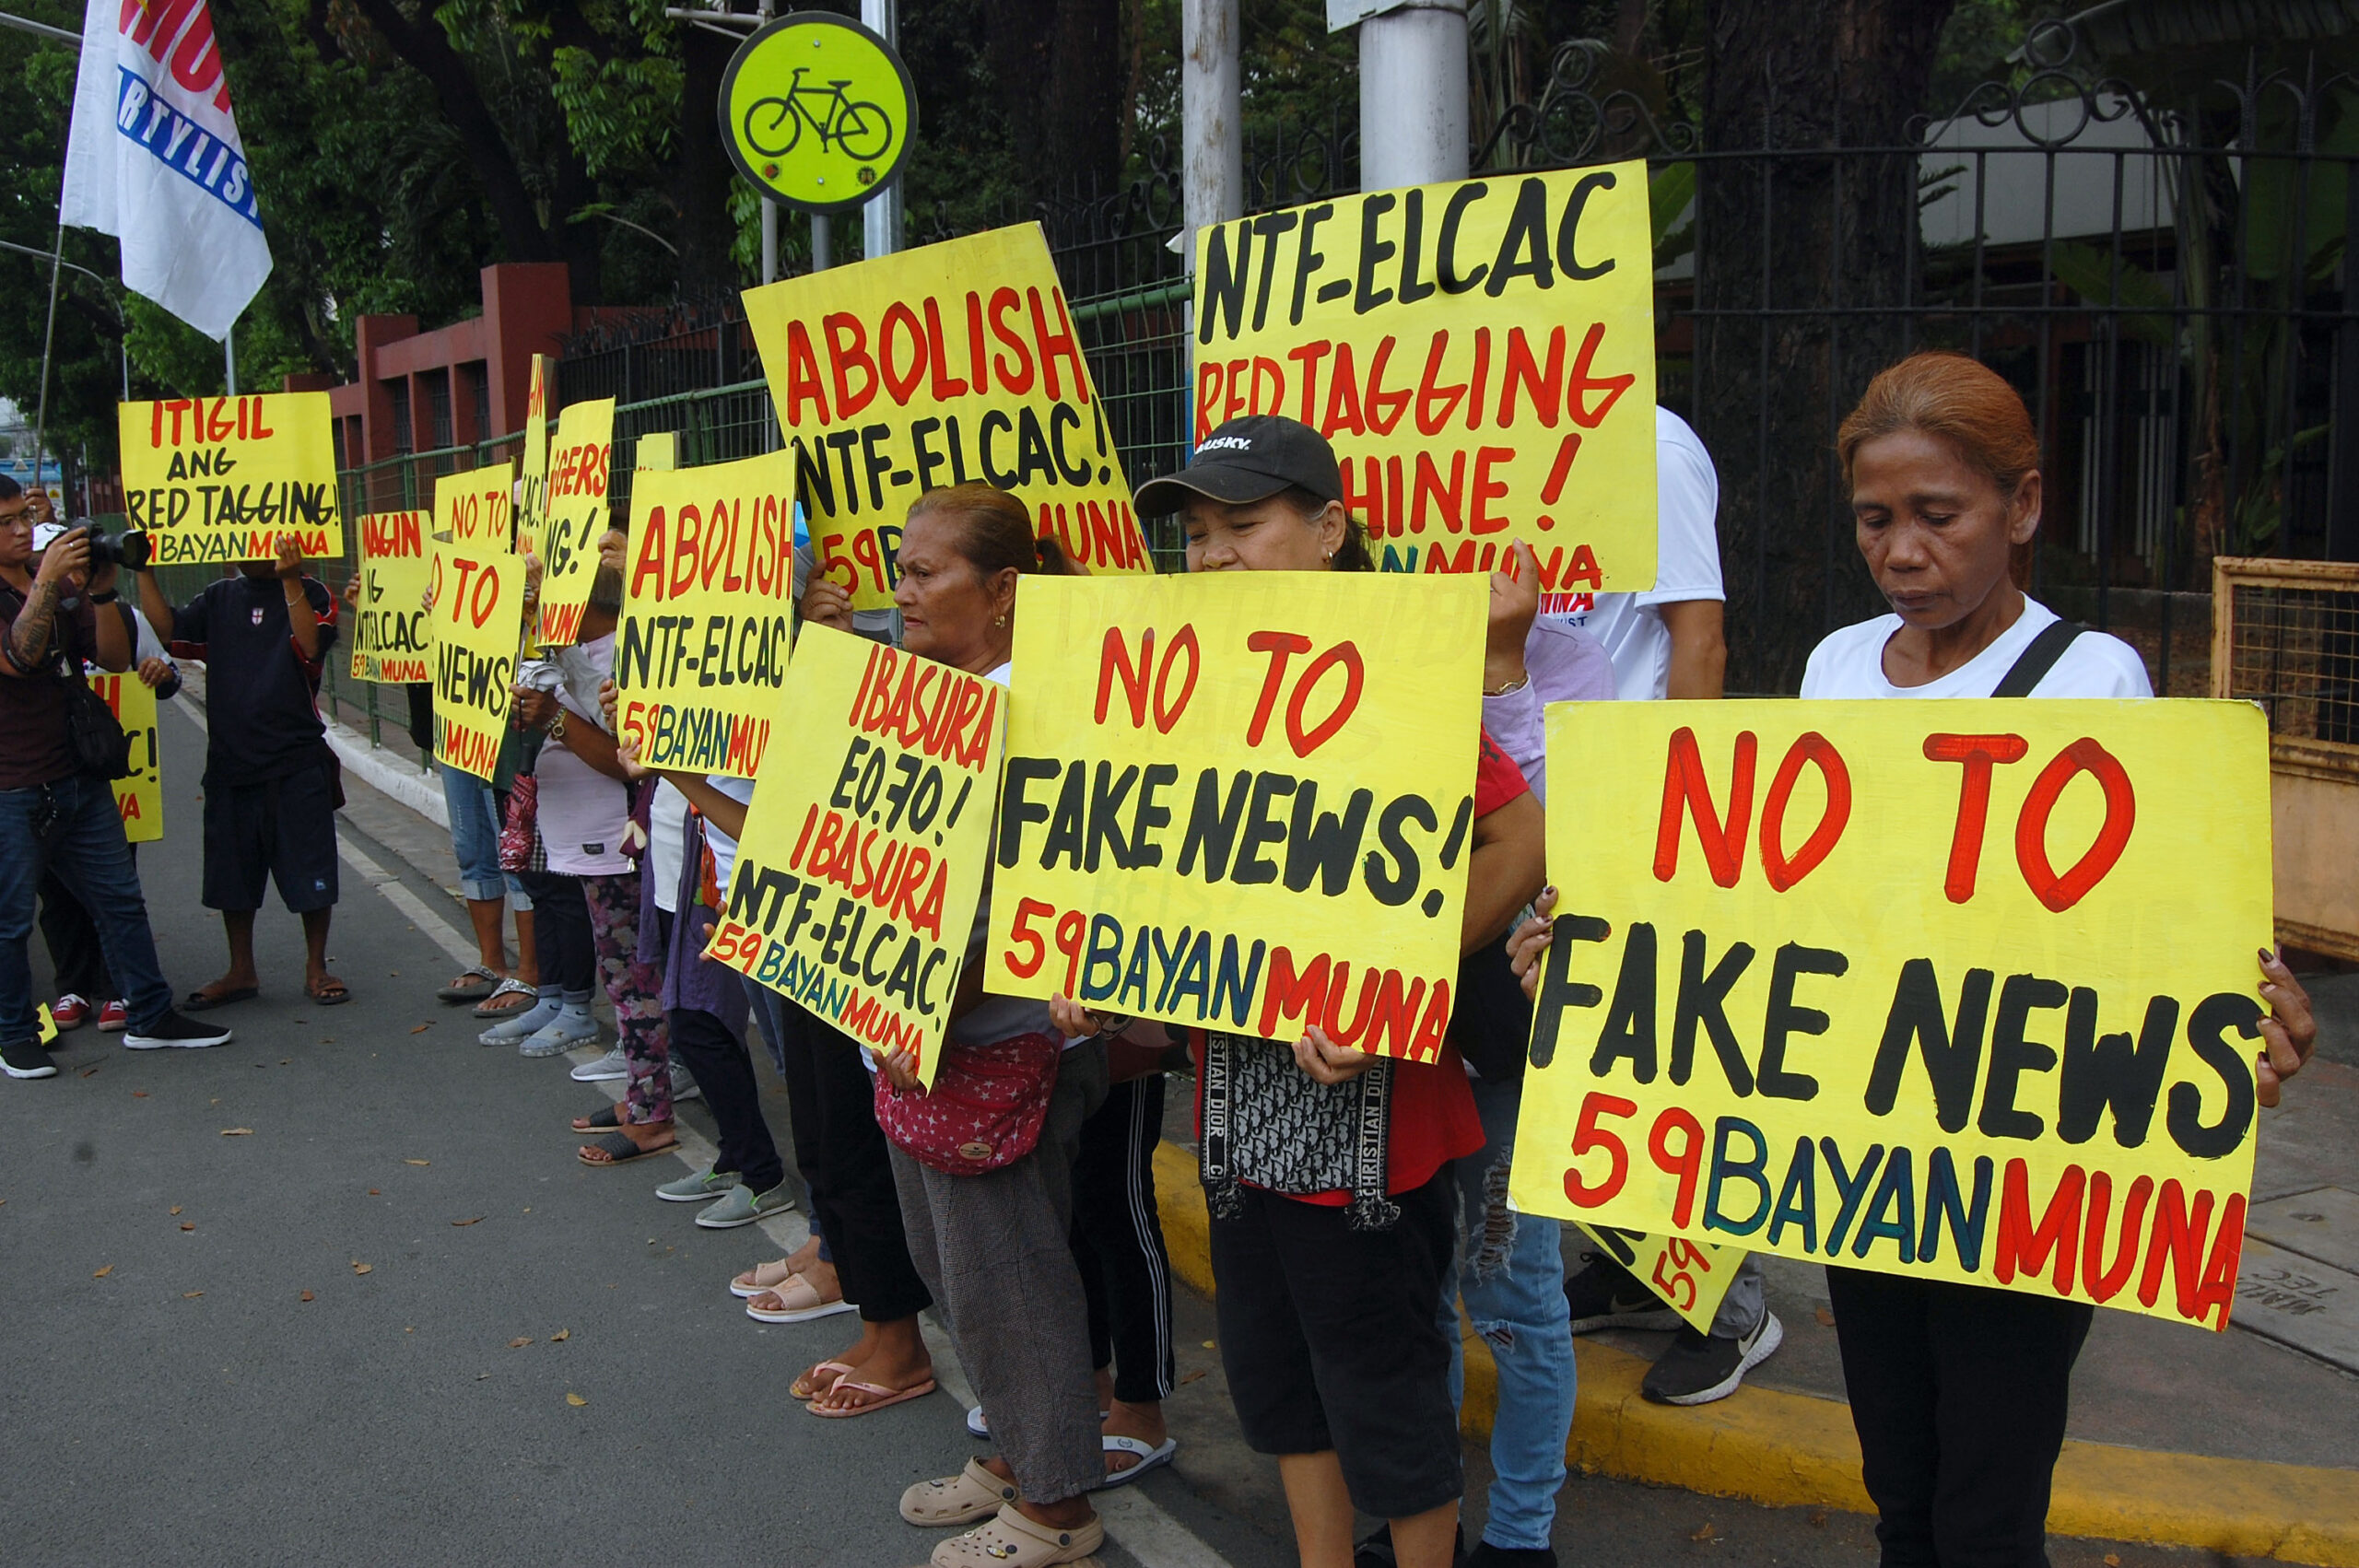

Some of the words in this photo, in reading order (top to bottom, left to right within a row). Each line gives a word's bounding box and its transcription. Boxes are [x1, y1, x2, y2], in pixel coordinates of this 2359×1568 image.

[118, 77, 258, 218] RTYLIS
[1199, 171, 1617, 345] NTF-ELCAC
[786, 286, 1089, 427] ABOLISH
[1287, 322, 1636, 440] TAGGING
[151, 396, 274, 449] ITIGIL
[167, 447, 238, 482] ANG
[791, 393, 1111, 521] NTF-ELCAC!
[126, 486, 190, 531] RED
[196, 481, 339, 527] TAGGING!
[452, 493, 478, 539] NO
[485, 489, 508, 539] TO
[630, 494, 792, 603] ABOLISH
[452, 557, 499, 629] TO
[849, 642, 997, 774] IBASURA
[1094, 623, 1200, 735] NO
[1247, 630, 1365, 758] TO
[790, 802, 948, 943] IBASURA
[997, 757, 1179, 873] FAKE
[1176, 767, 1473, 919] NEWS!
[1652, 726, 1852, 893] NO
[1922, 732, 2137, 913] TO
[727, 859, 963, 1034] NTF-ELCAC!
[1529, 914, 1849, 1100] FAKE
[1864, 957, 2260, 1161] NEWS
[1210, 1098, 1226, 1138] DIOR
[1362, 1106, 1380, 1199] CHRISTIAN
[1652, 1235, 1711, 1312] 59
